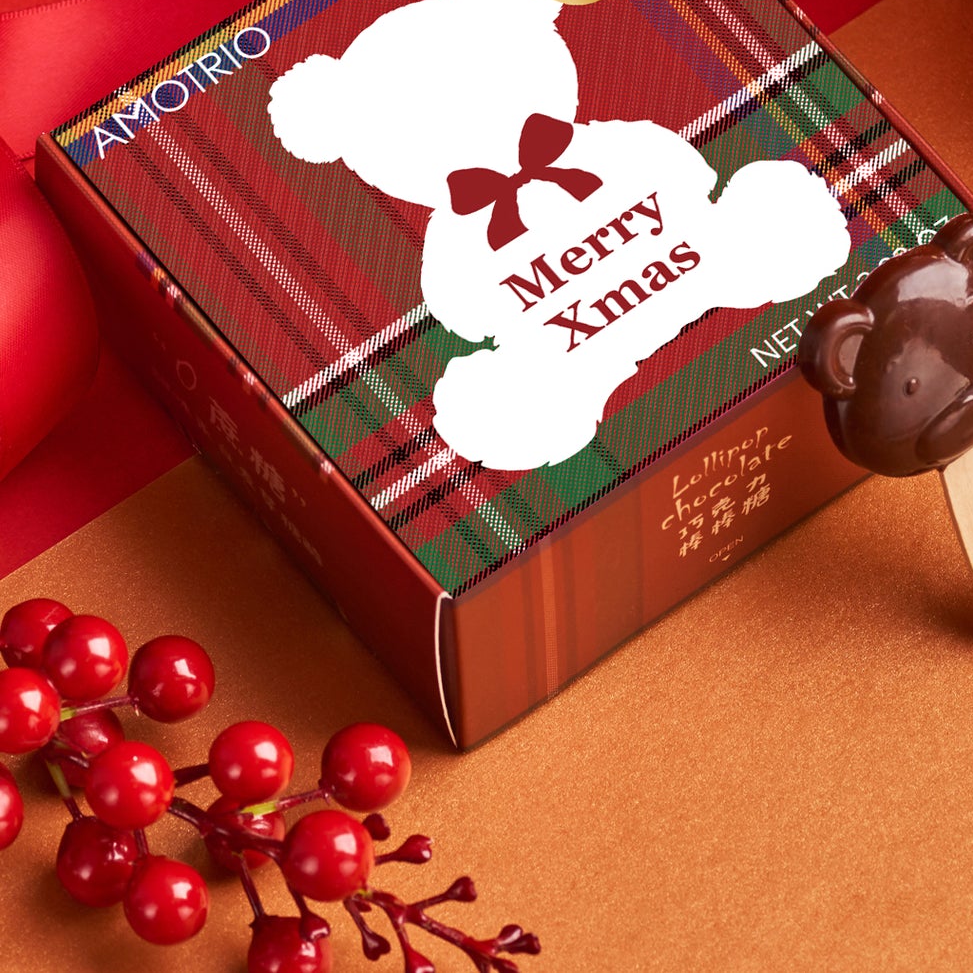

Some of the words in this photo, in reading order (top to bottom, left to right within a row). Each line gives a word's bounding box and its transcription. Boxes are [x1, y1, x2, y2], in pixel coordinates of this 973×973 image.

[93, 27, 271, 160] AMOTRIO
[499, 191, 663, 312] Merry
[543, 241, 701, 352] Xmas
[750, 318, 802, 368] NET
[661, 435, 793, 530] chocolate
[672, 427, 768, 500] Lollipop
[709, 535, 744, 563] OPEN
